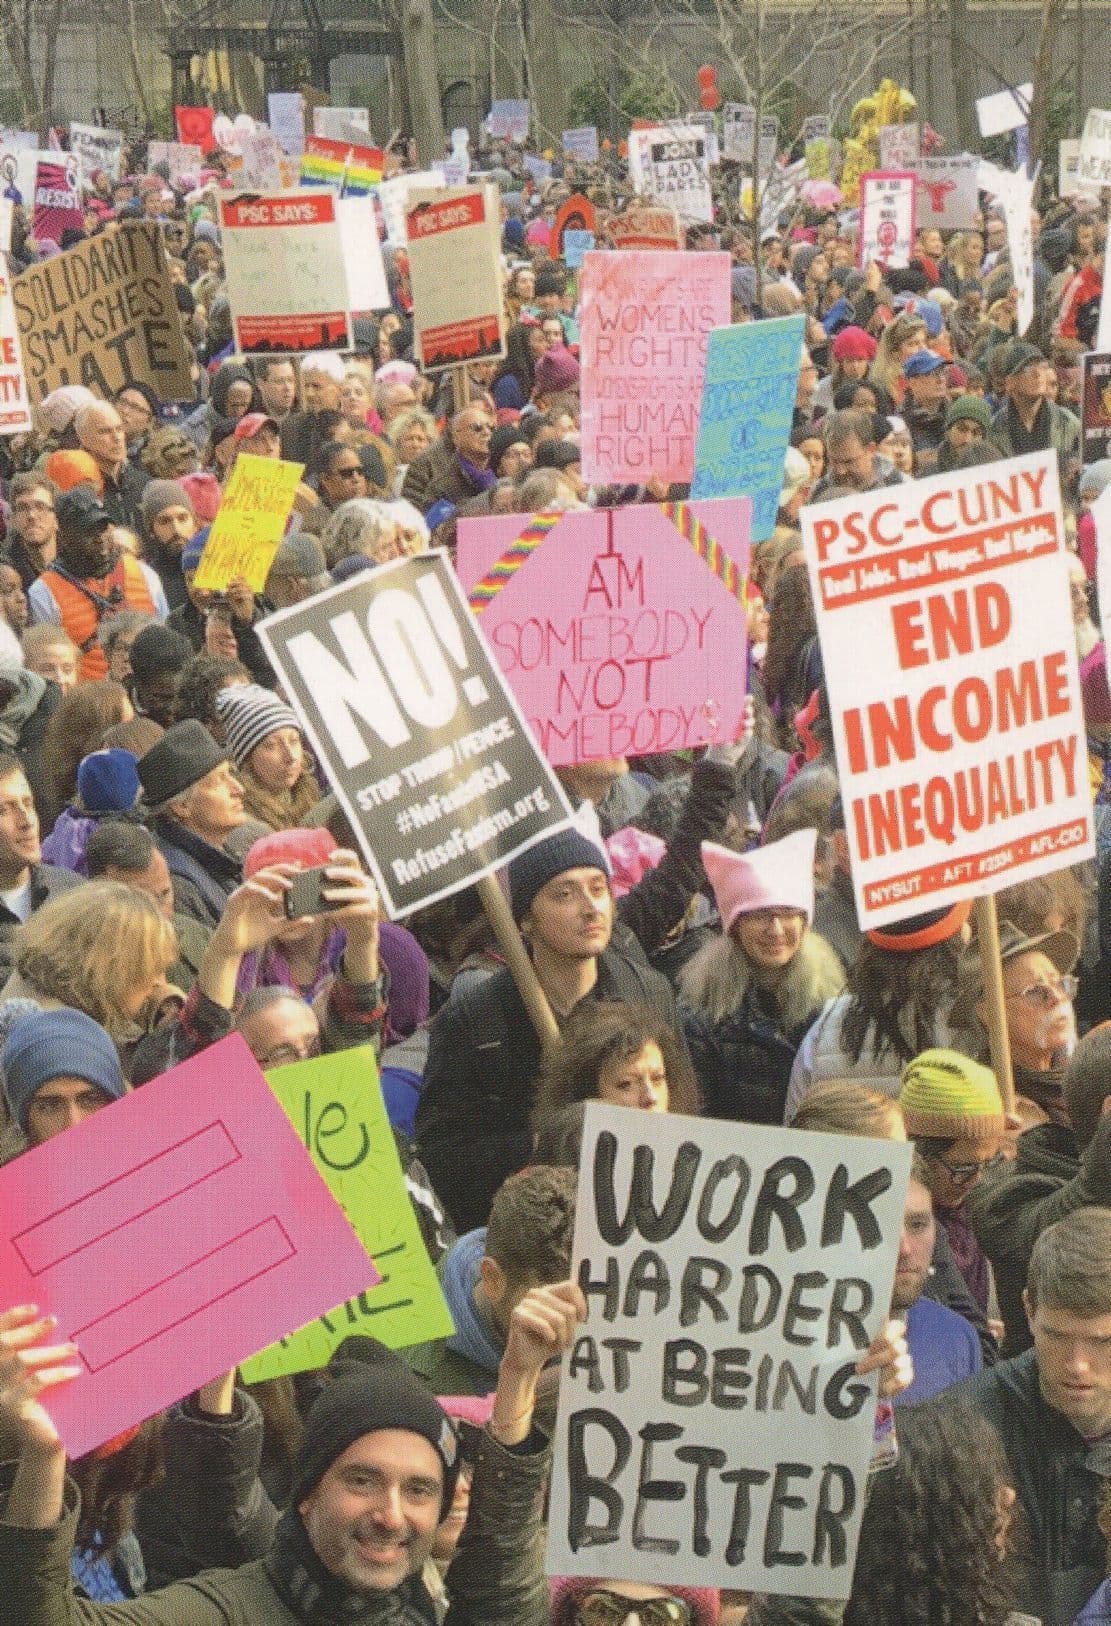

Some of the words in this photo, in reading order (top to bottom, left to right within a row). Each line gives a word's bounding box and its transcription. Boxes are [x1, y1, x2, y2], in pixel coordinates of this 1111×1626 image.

[237, 205, 269, 224] PSC
[13, 223, 163, 334] SOLIDARITY
[28, 278, 165, 377] SMASHES
[592, 507, 624, 559] I
[813, 467, 1047, 561] PSC-CUNY
[583, 555, 644, 611] AM
[890, 581, 1011, 670] END
[286, 572, 489, 769] NO!
[492, 607, 713, 673] SOMEBODY
[557, 655, 672, 713] NOT
[843, 651, 1072, 775] INCOME
[356, 774, 402, 811] STOP
[853, 734, 1077, 862] INEQUALITY
[869, 876, 922, 904] NYSUT
[943, 862, 973, 883] AFT
[593, 1130, 892, 1256] WORK
[579, 1250, 874, 1350] HARDER
[570, 1335, 642, 1394] AT
[662, 1338, 871, 1420] BEING
[567, 1407, 856, 1569] BETTER
